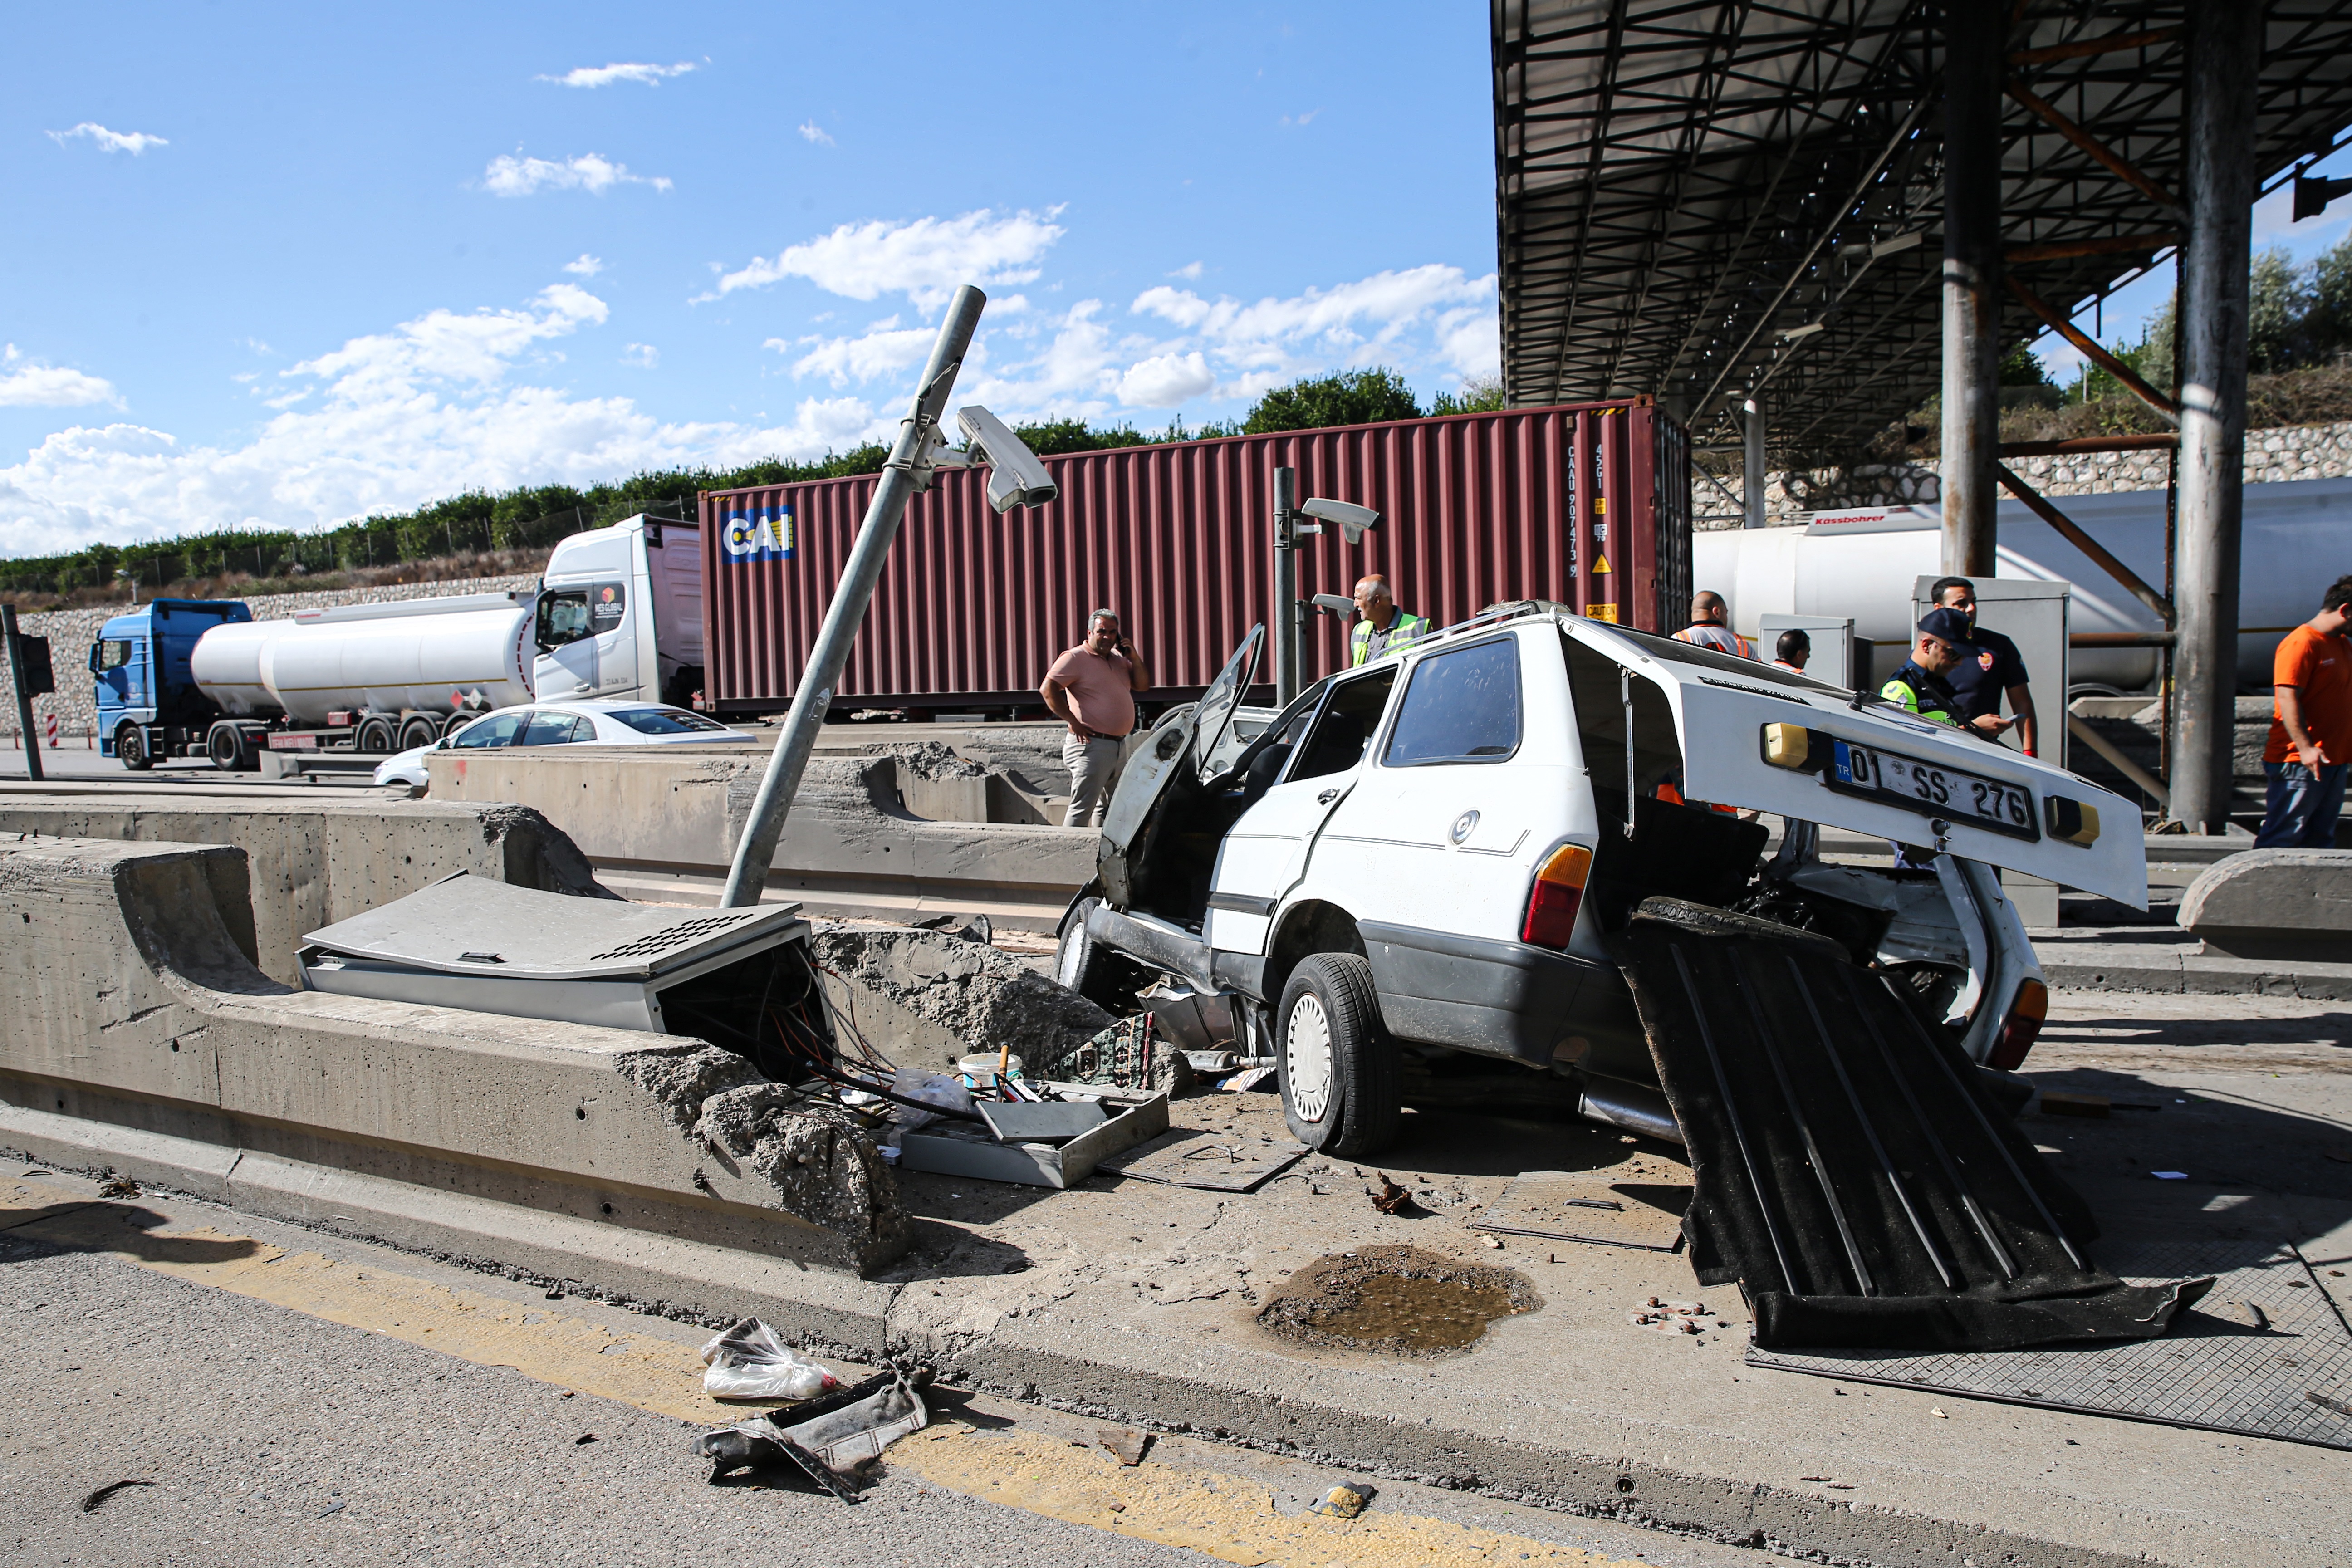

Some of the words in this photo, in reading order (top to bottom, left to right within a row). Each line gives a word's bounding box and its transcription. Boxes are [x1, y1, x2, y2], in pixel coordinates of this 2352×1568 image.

[723, 514, 789, 555] CAI
[1570, 565, 1577, 576] 9
[1837, 764, 1850, 776] TR
[1850, 749, 1882, 787] 01
[1911, 767, 1949, 805] SS
[1971, 782, 2027, 825] 276
